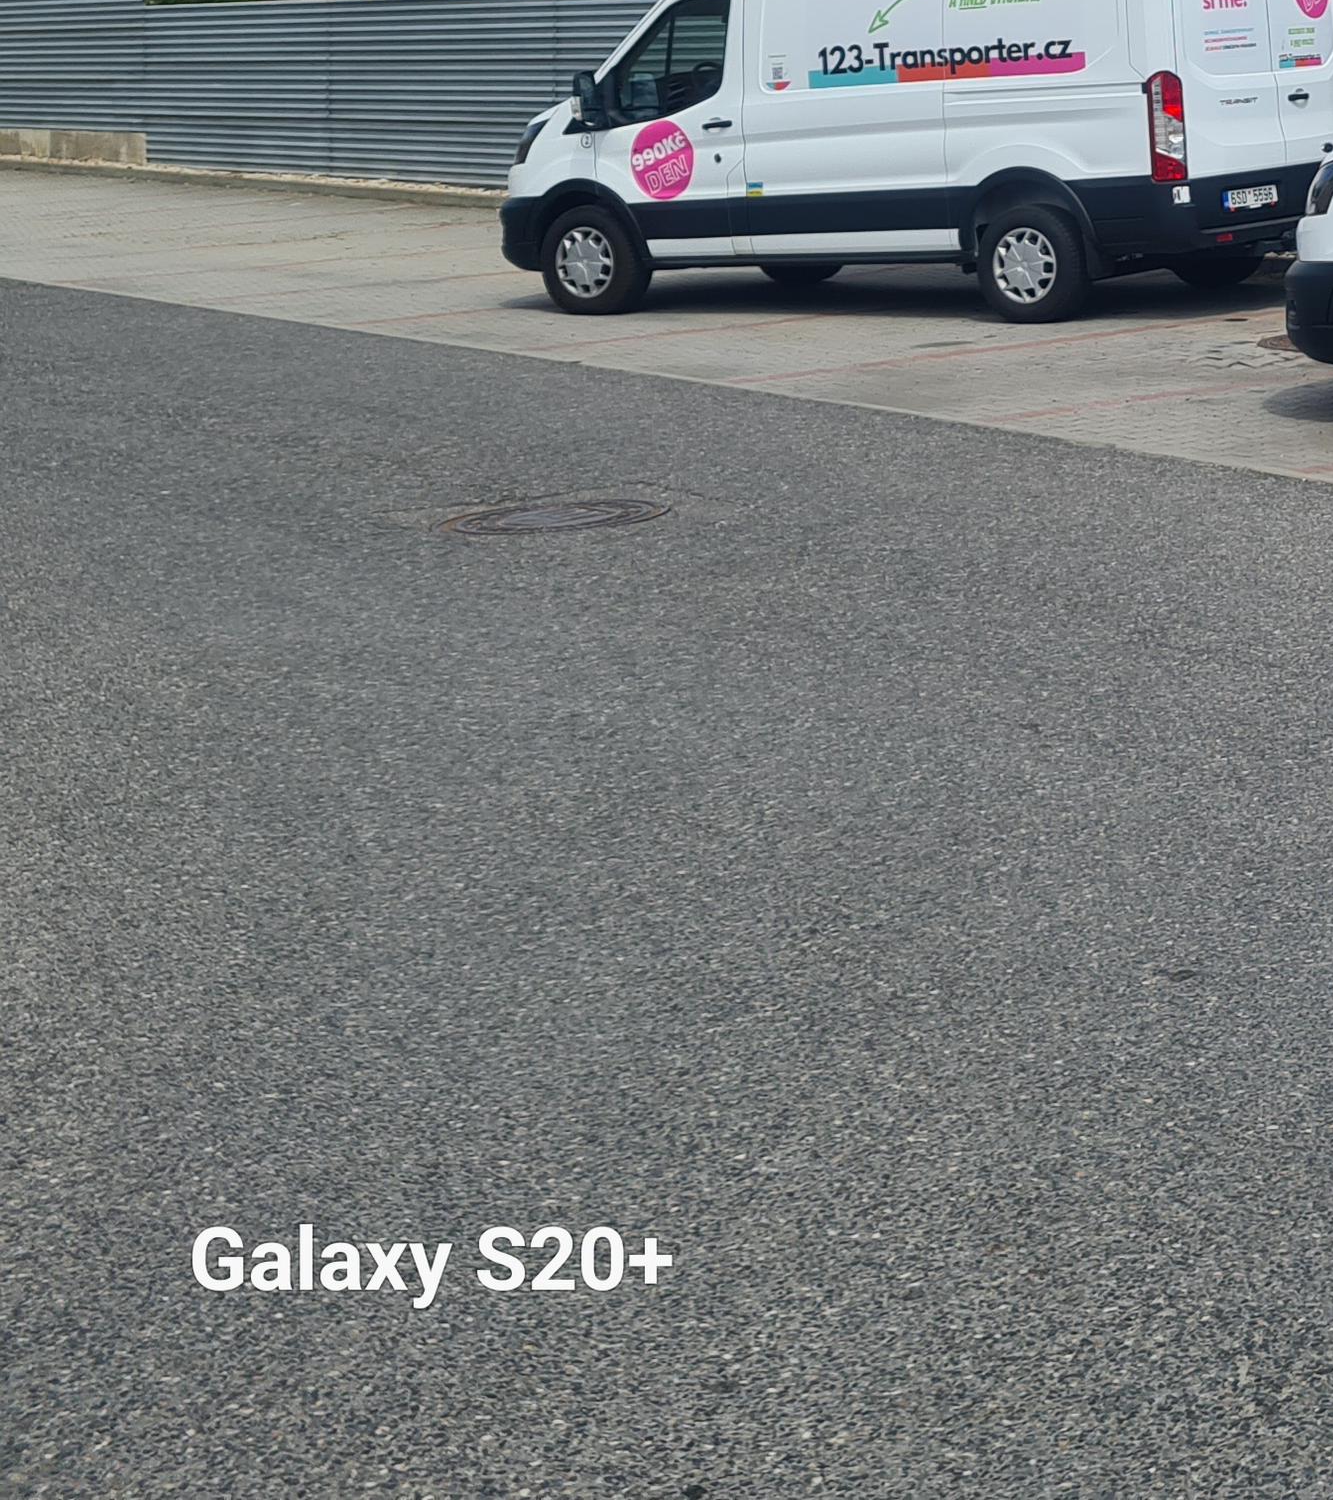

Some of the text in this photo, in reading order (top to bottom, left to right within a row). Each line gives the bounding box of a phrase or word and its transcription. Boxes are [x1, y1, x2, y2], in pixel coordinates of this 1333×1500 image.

[818, 37, 1073, 76] 123-Transporter.cz
[631, 130, 687, 172] 990Kč
[644, 154, 690, 195] DEN
